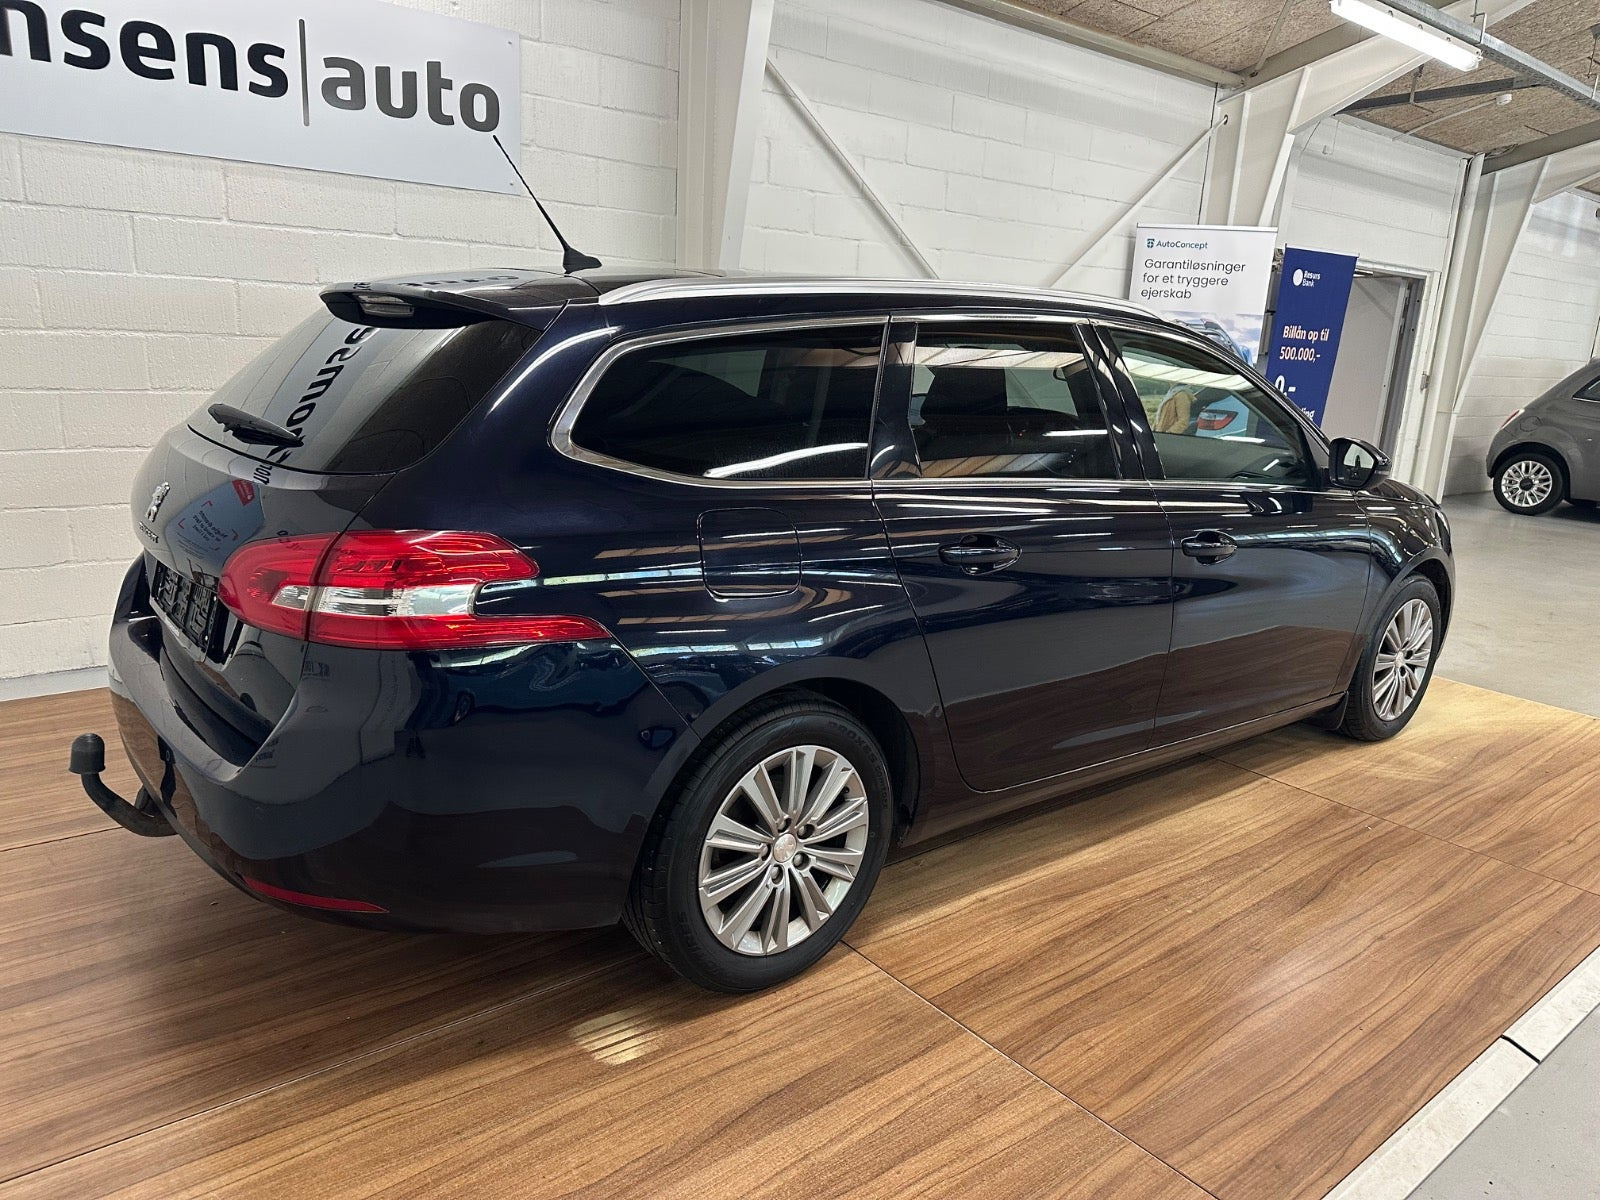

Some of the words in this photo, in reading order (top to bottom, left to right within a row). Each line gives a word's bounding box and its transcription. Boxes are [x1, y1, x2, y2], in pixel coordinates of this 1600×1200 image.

[321, 56, 500, 132] auto
[1156, 240, 1208, 251] AutoConcept
[1144, 258, 1247, 275] Garantiløsninger
[1142, 272, 1160, 284] for
[1162, 274, 1175, 284] et
[1177, 274, 1229, 289] tryggere
[1301, 278, 1315, 288] Bank
[1140, 286, 1192, 301] ejerskab
[1282, 325, 1307, 340] Billån
[1307, 330, 1319, 344] op
[1320, 328, 1330, 342] til
